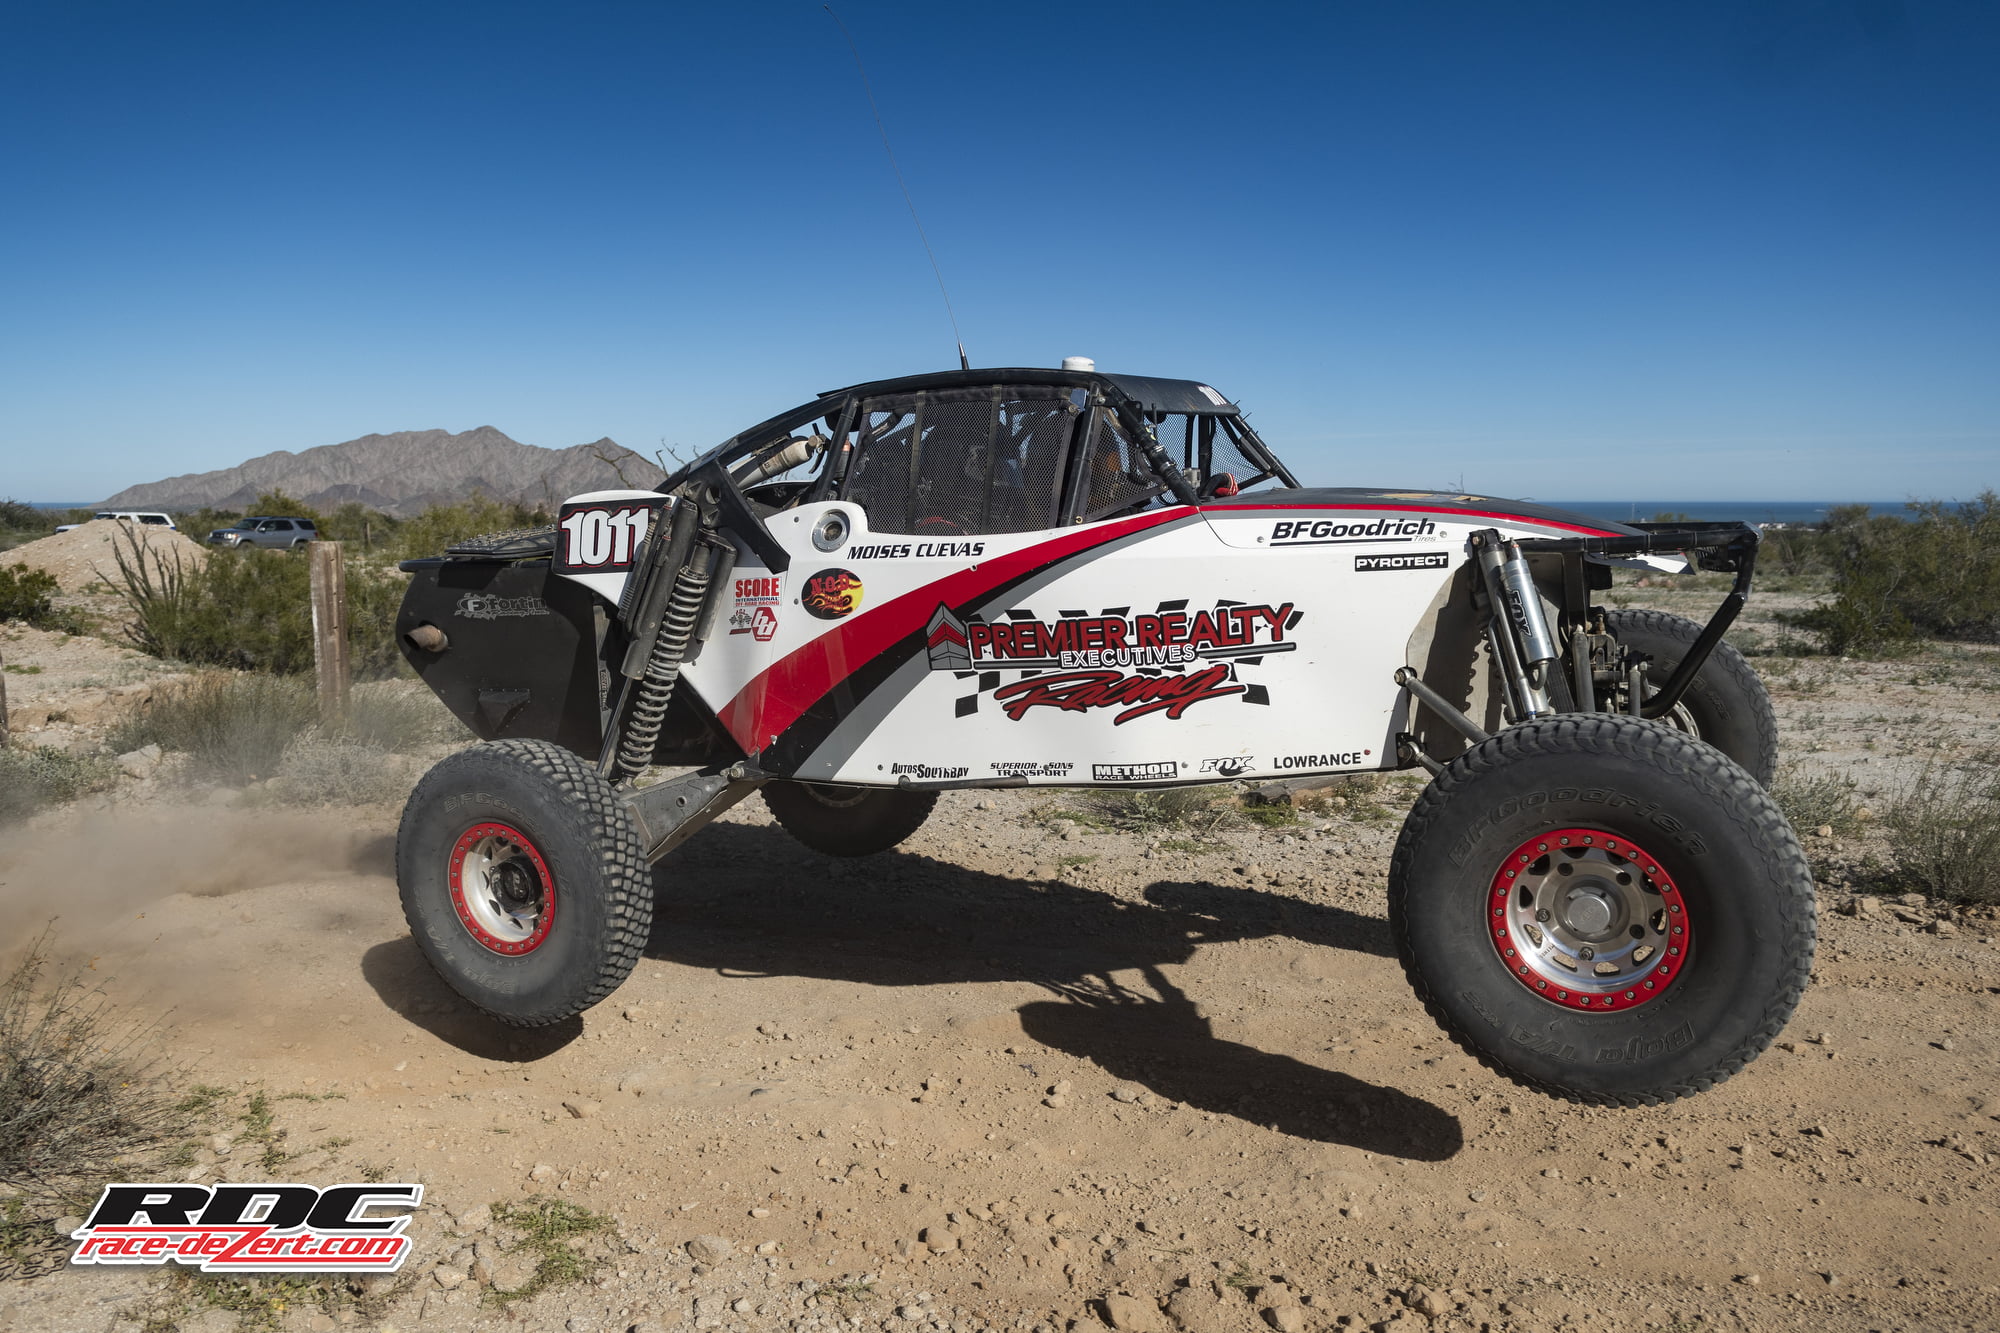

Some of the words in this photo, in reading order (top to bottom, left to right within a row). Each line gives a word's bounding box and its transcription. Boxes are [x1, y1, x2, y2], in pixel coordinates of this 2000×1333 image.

[560, 506, 650, 567] 1011
[1272, 518, 1436, 540] BFGoodrich
[847, 544, 912, 559] MOISES
[916, 543, 985, 557] CUEVAS
[1356, 555, 1447, 568] PYROTECT
[735, 578, 780, 598] SCORE
[970, 616, 1128, 660] PREMIER
[1135, 602, 1295, 650] REALTY
[1059, 642, 1196, 669] EXECUTIVES
[994, 664, 1247, 726] Racing
[990, 762, 1037, 770] SUPERIOR
[1048, 762, 1074, 770] SONS
[1094, 763, 1175, 776] METHOD
[1199, 756, 1255, 777] FOX
[1274, 753, 1361, 769] LOWRANCE
[997, 769, 1068, 777] TRANSPORT
[1450, 786, 1709, 868] BFGoodrich
[1510, 1023, 1577, 1065] T/A
[1595, 1020, 1696, 1065] Baja
